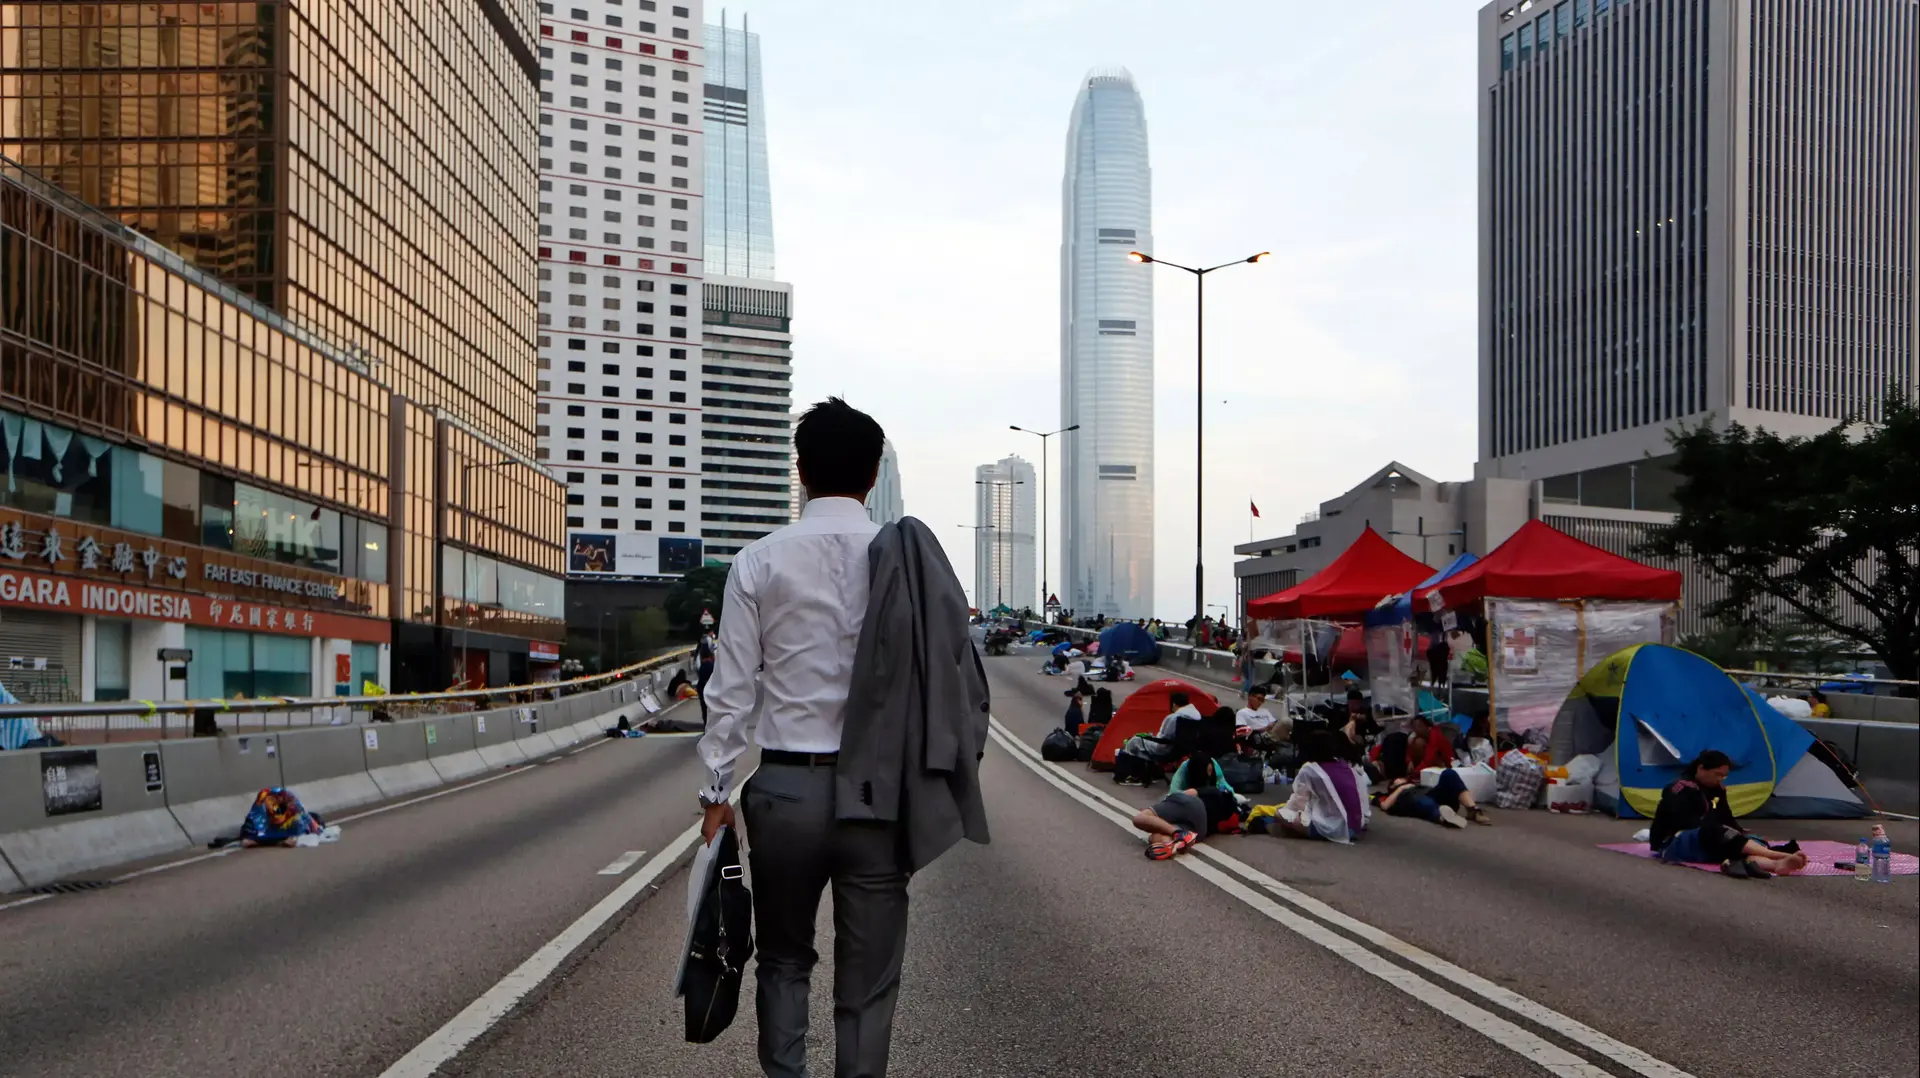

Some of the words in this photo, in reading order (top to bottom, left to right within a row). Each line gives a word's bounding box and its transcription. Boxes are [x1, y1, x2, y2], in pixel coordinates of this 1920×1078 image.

[0, 520, 188, 580] 遠東金融中心
[0, 574, 71, 606] GARA
[82, 584, 192, 619] INDONESIA
[204, 563, 228, 583] FAR
[229, 568, 258, 587] EAST
[261, 573, 302, 594] FINANCE
[304, 579, 340, 599] CENTRE
[209, 601, 315, 632] 印尼國家銀行
